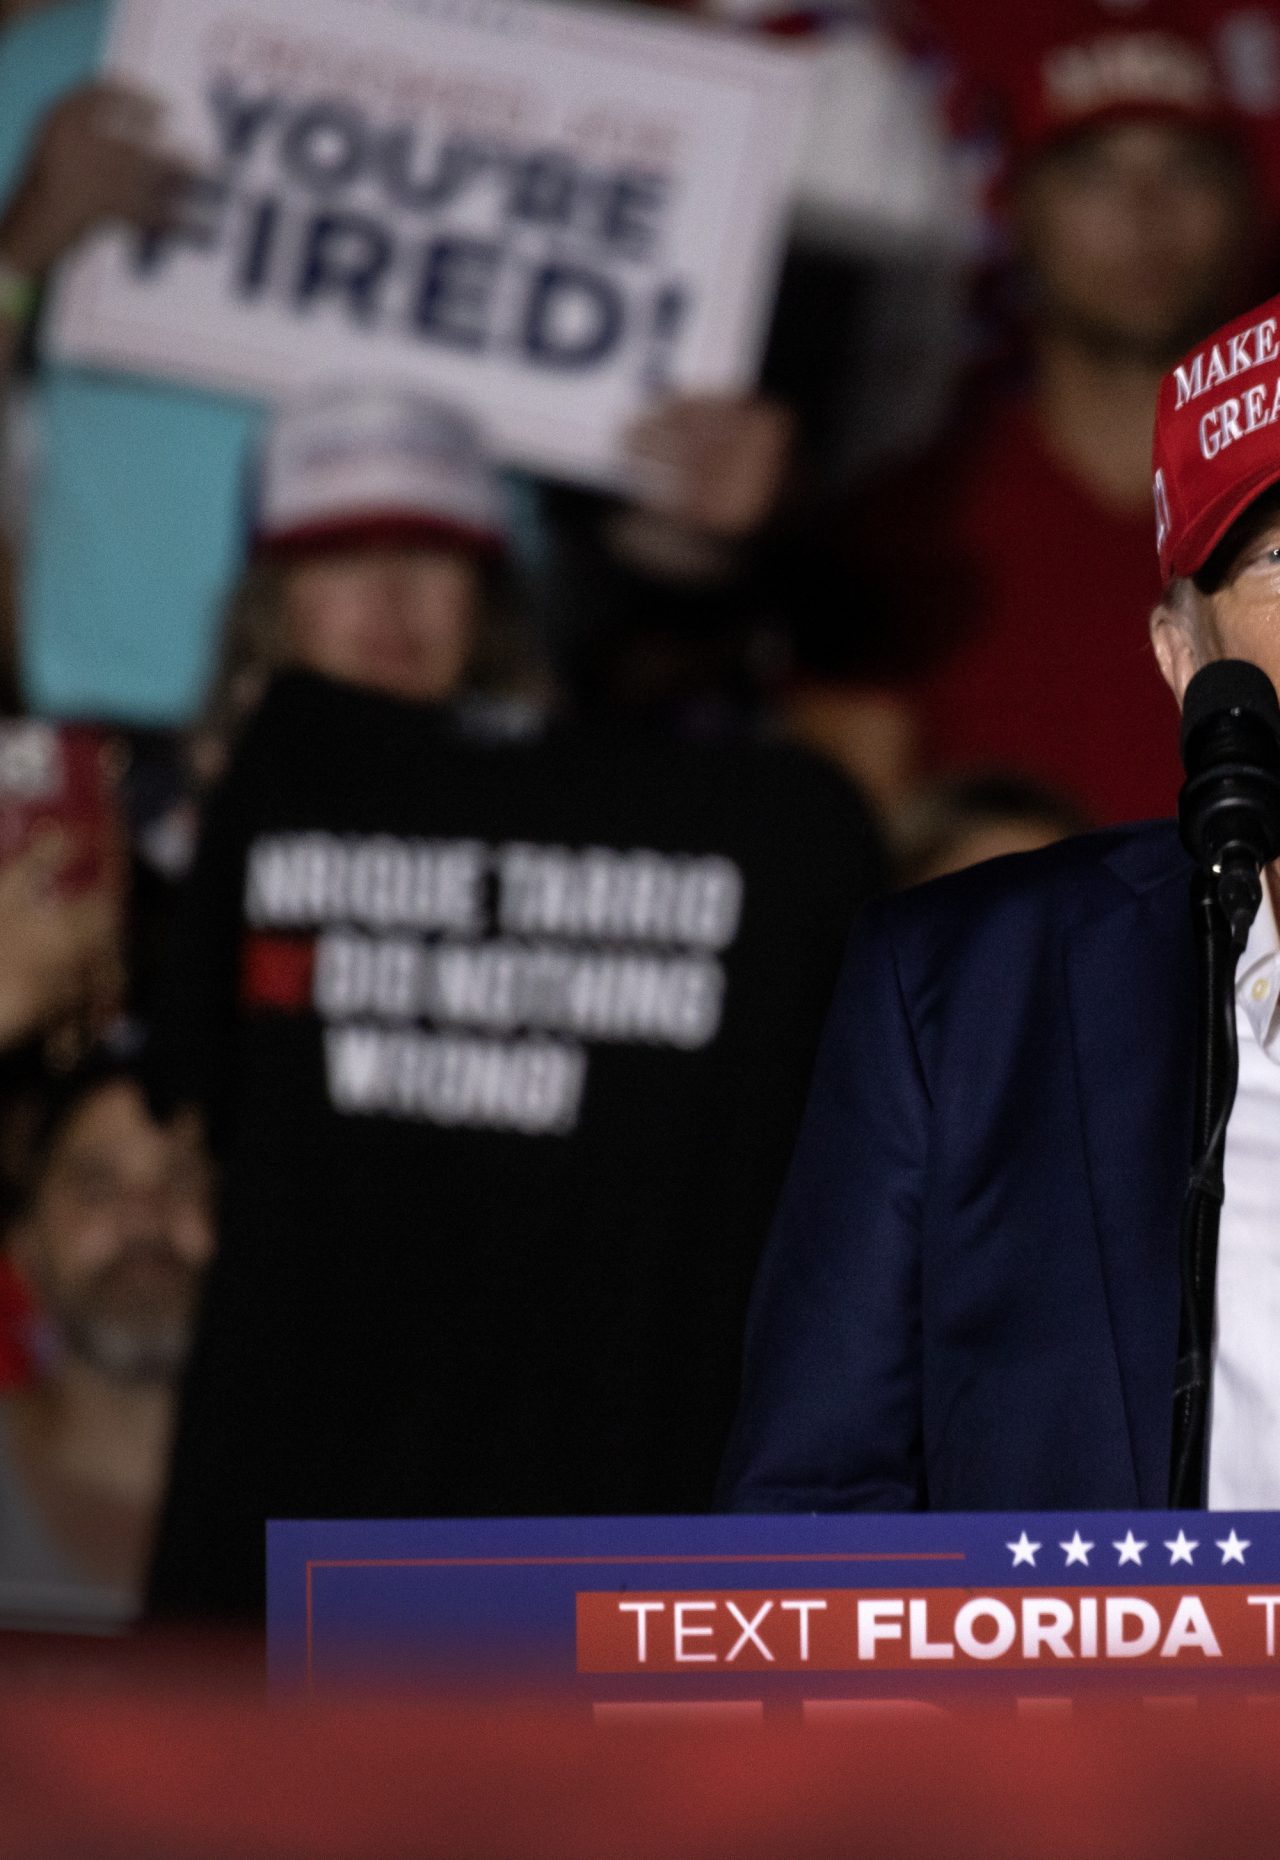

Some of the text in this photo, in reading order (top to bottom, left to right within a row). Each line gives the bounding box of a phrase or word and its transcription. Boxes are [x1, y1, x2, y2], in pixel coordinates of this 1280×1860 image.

[205, 72, 676, 262] YOU'RE
[1173, 318, 1280, 411] MAKE
[618, 1600, 827, 1662] TEXT
[857, 1596, 1223, 1661] FLORIDA
